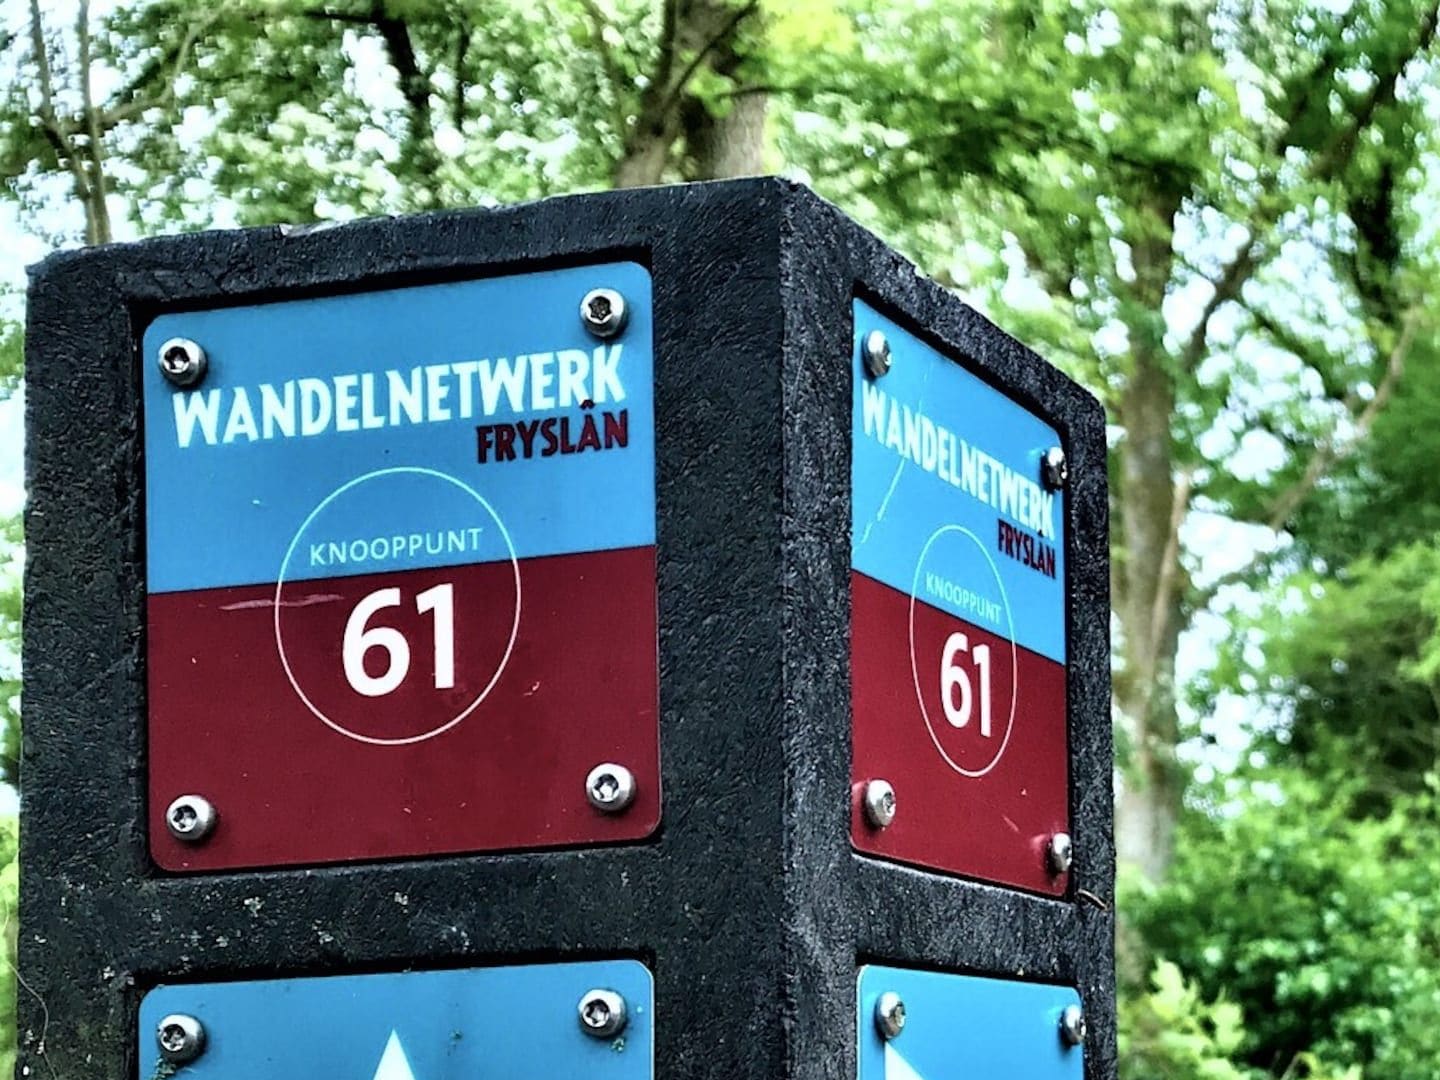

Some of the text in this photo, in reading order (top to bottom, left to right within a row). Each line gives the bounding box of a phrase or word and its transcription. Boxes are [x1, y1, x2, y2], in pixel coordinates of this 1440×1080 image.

[173, 344, 627, 448] WANDELNETWERK
[476, 401, 629, 464] FRYSLÂN
[861, 380, 1055, 541] WANDELNETWERK
[310, 527, 484, 566] KNOOPPUNT
[925, 571, 1002, 625] KNOOPPUNT
[342, 583, 455, 697] 61
[940, 632, 992, 738] 61
